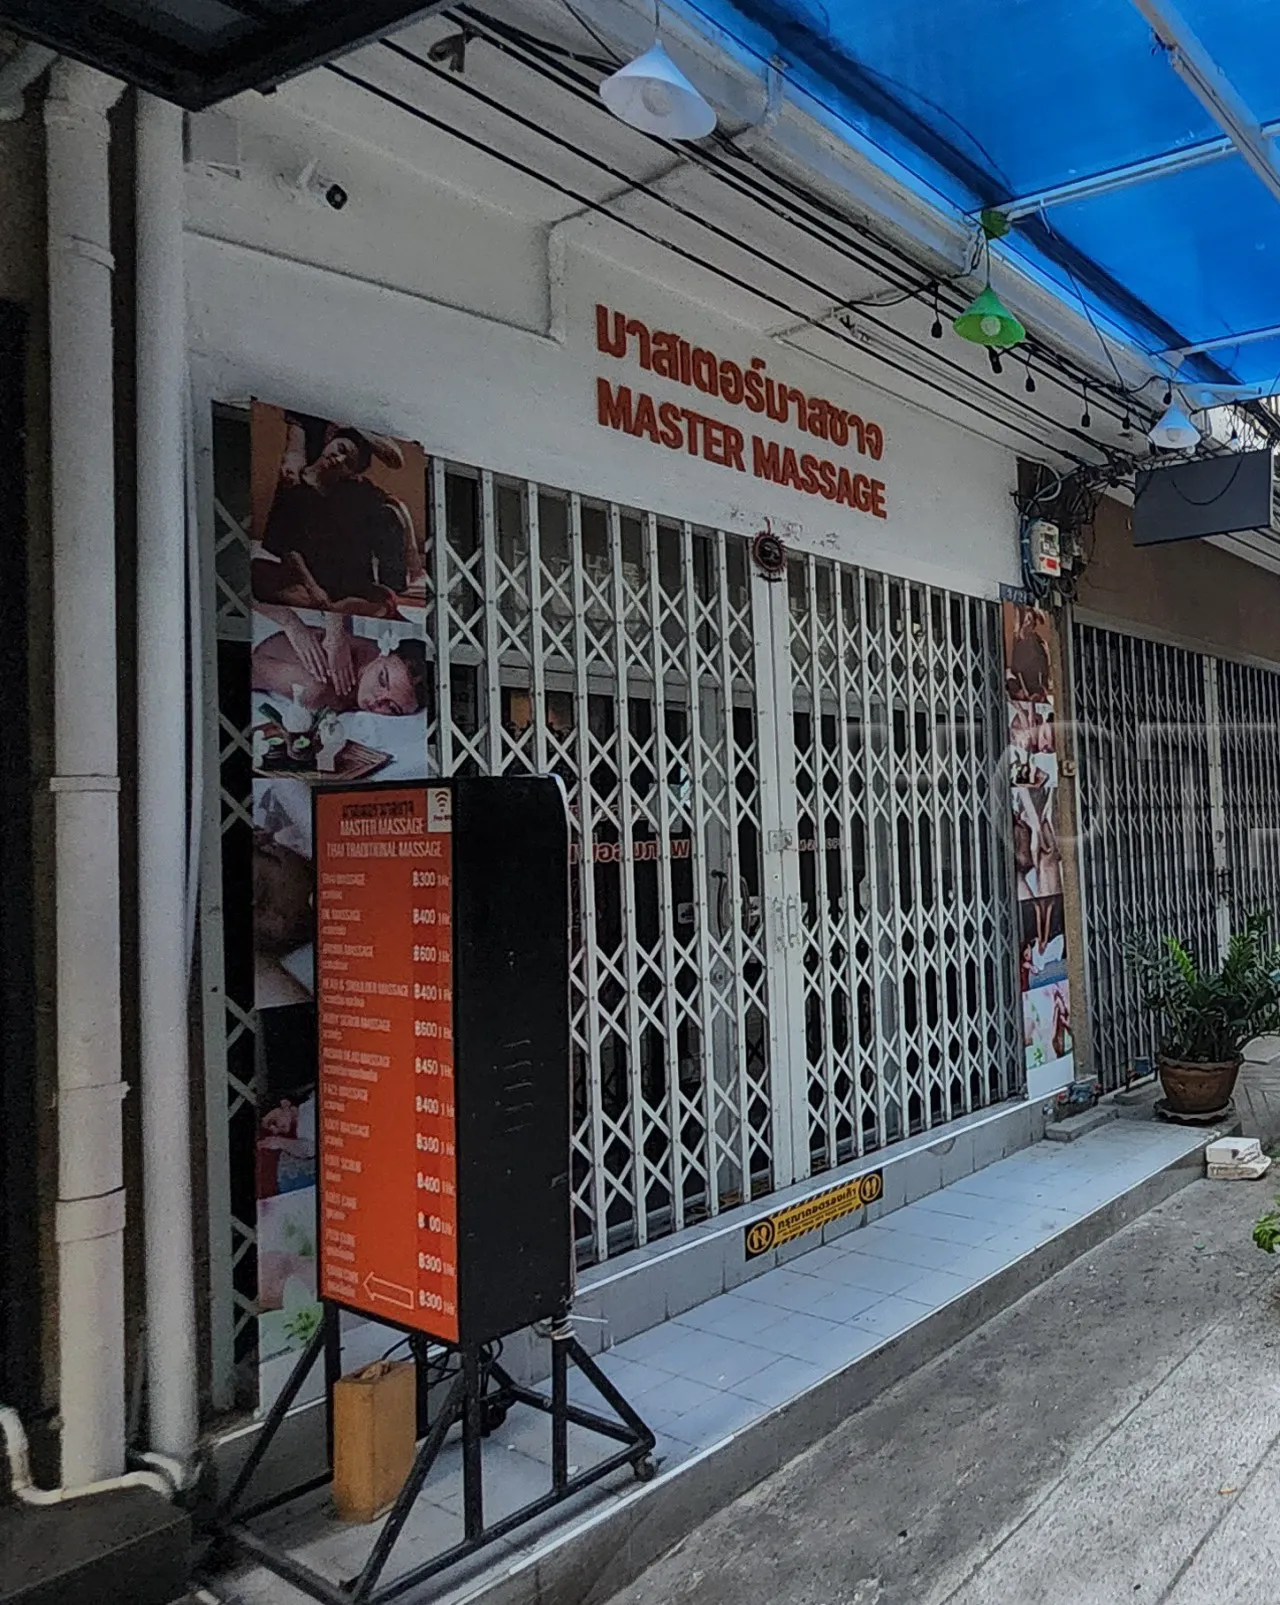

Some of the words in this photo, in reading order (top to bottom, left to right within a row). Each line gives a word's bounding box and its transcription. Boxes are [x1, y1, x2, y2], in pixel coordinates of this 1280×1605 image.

[597, 377, 746, 472] MASTER
[752, 435, 887, 519] MASSAGE
[340, 818, 379, 836] MASTER
[379, 816, 424, 836] MASSAGE
[398, 840, 443, 858] MASSAGE
